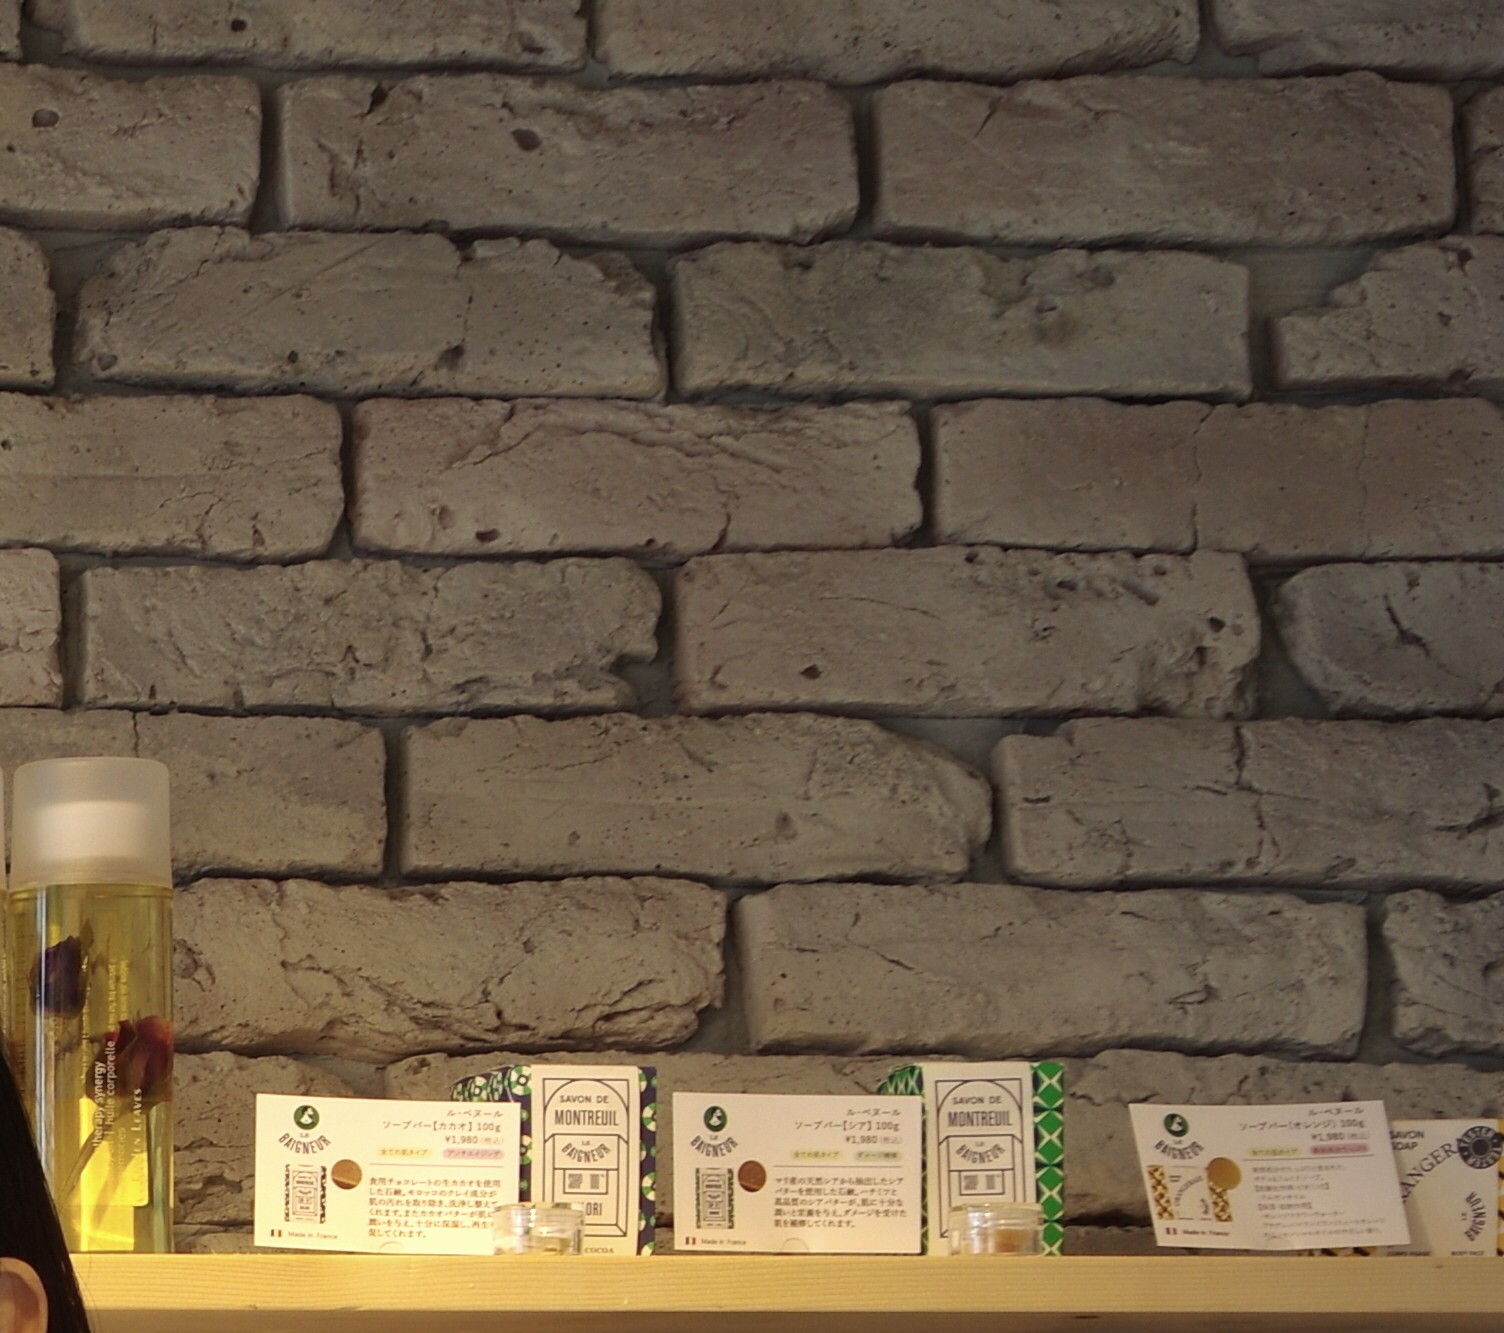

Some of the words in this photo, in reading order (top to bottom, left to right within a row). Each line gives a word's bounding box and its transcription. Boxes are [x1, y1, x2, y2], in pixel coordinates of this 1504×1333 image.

[106, 1040, 116, 1090] corporelle
[94, 1061, 106, 1105] synergy
[555, 1110, 618, 1126] MONTREUIL
[948, 1111, 1012, 1126] MONTREUIL
[477, 1123, 501, 1132] 100g
[278, 1133, 331, 1154] BAIGNEUR
